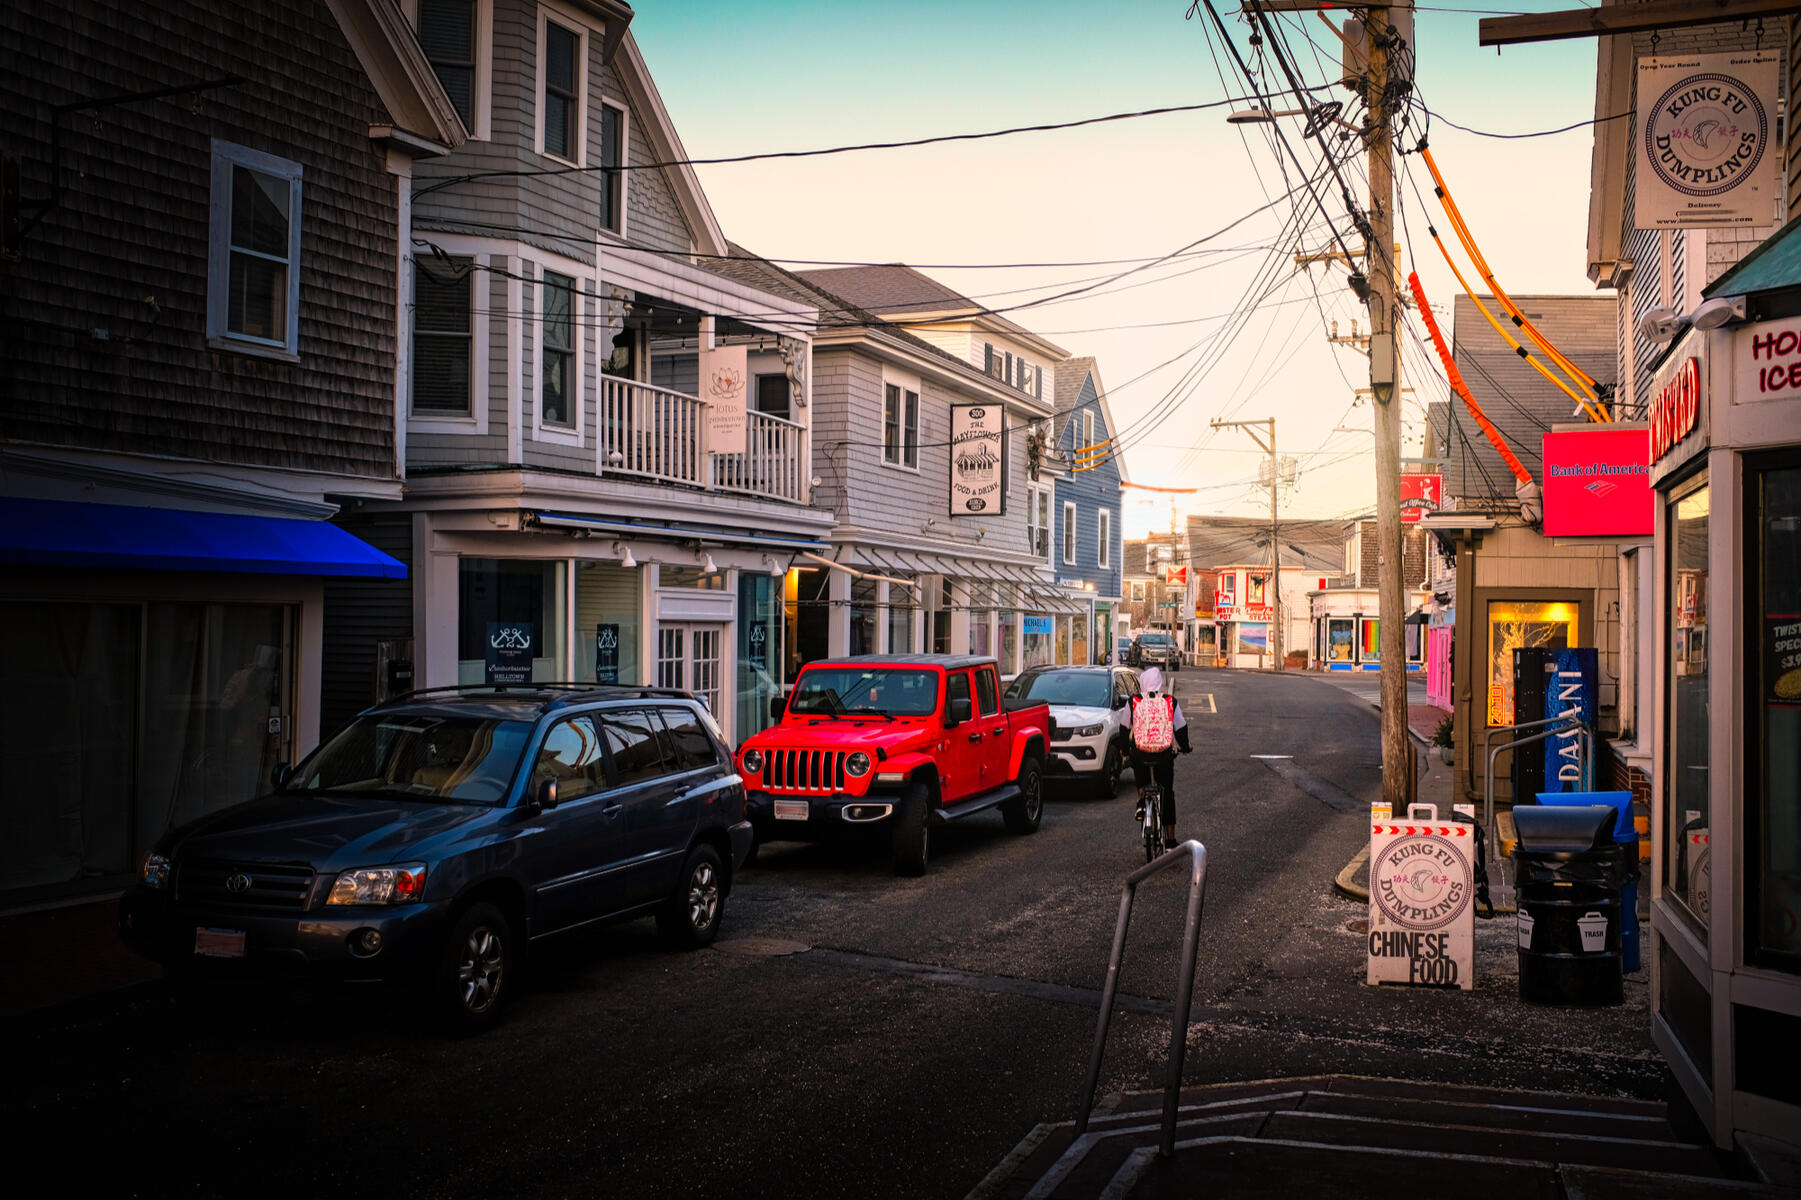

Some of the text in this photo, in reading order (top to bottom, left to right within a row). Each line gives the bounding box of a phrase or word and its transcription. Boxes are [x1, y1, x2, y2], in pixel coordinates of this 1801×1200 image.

[1666, 87, 1748, 119] KUNG FU
[1671, 128, 1692, 140] 功夫
[1656, 131, 1757, 184] DUMPLINGS
[1752, 330, 1801, 361] HO
[1759, 361, 1801, 393] ICE
[716, 403, 738, 414] lotus
[1649, 356, 1701, 467] TWISTED
[970, 421, 984, 429] THE
[953, 430, 1000, 446] MAYFLOWER
[1550, 463, 1582, 477] Bank
[1583, 462, 1599, 476] of
[954, 482, 971, 495] FOOD
[978, 481, 999, 495] DRINK
[1408, 498, 1425, 507] Office
[1388, 843, 1456, 867] KUNG FU
[1380, 878, 1464, 922] DUMPLINGS
[1369, 930, 1450, 960] CHINESE
[1584, 930, 1604, 938] TRASH
[1408, 957, 1459, 985] FOOD
